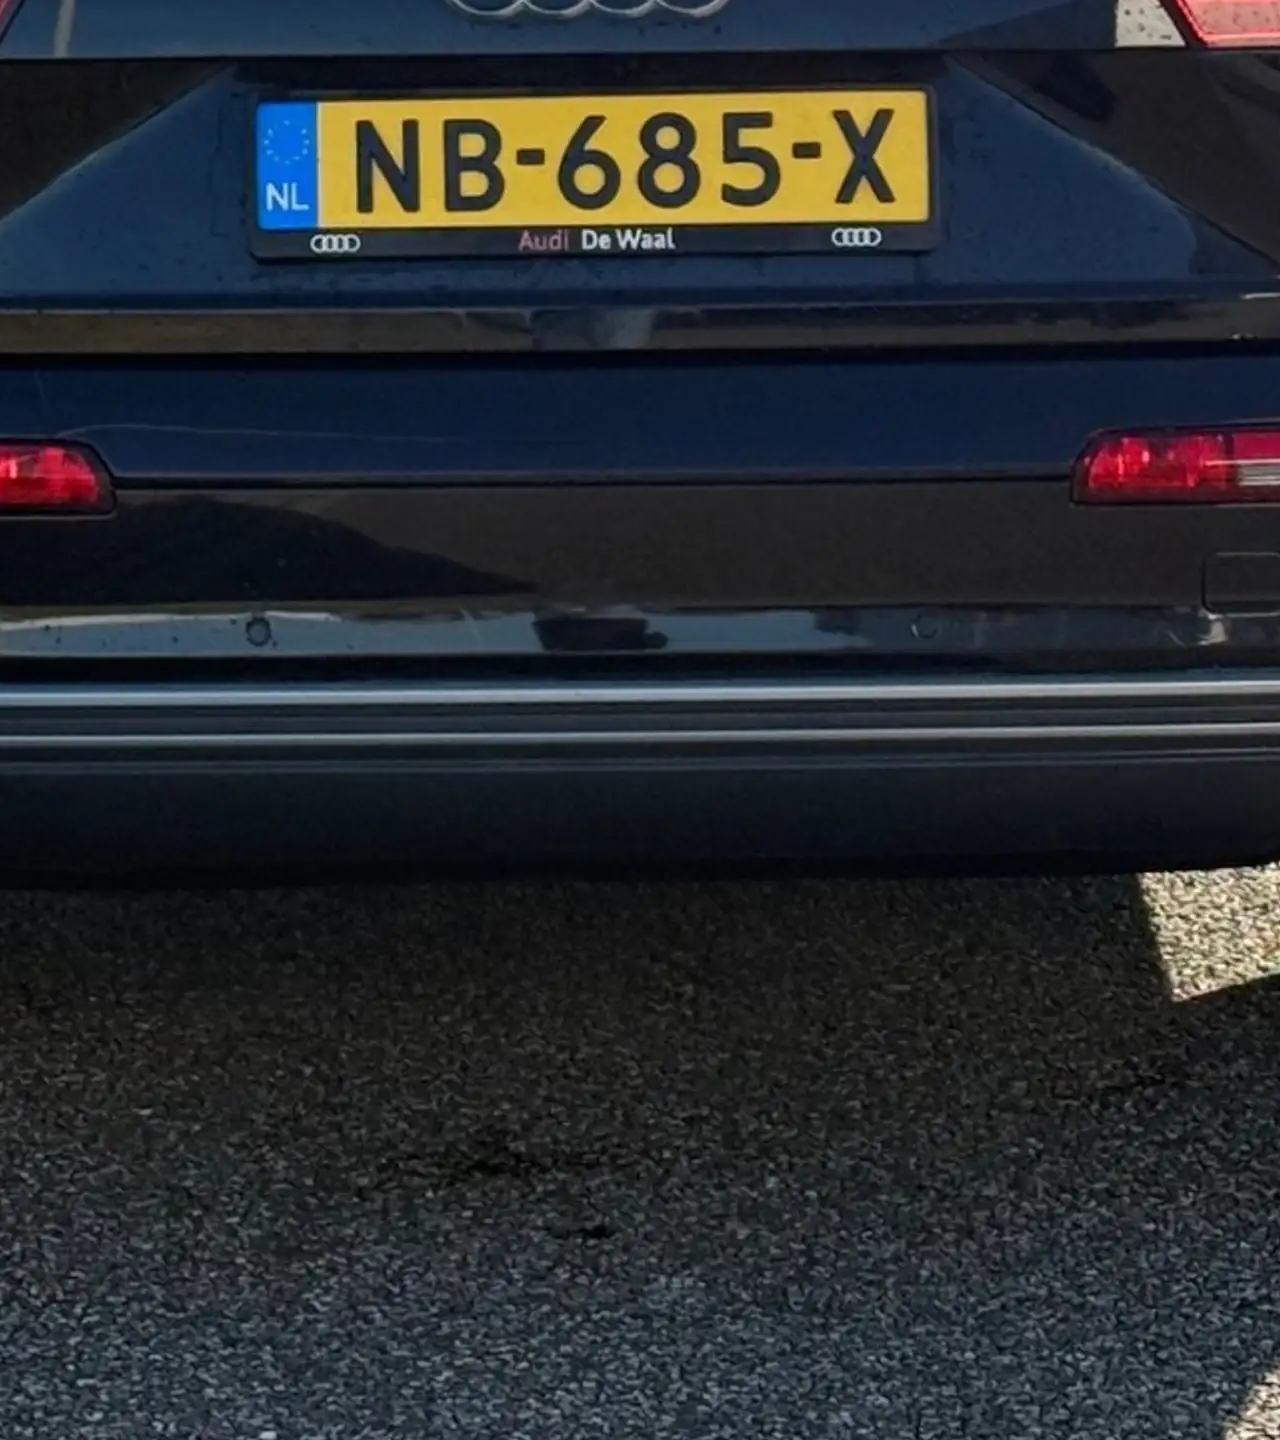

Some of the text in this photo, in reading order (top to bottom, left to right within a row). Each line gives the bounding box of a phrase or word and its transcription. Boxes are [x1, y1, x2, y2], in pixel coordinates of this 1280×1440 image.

[355, 108, 896, 213] NB-685-X
[266, 182, 309, 212] NL
[519, 228, 676, 251] Audi De Waal
